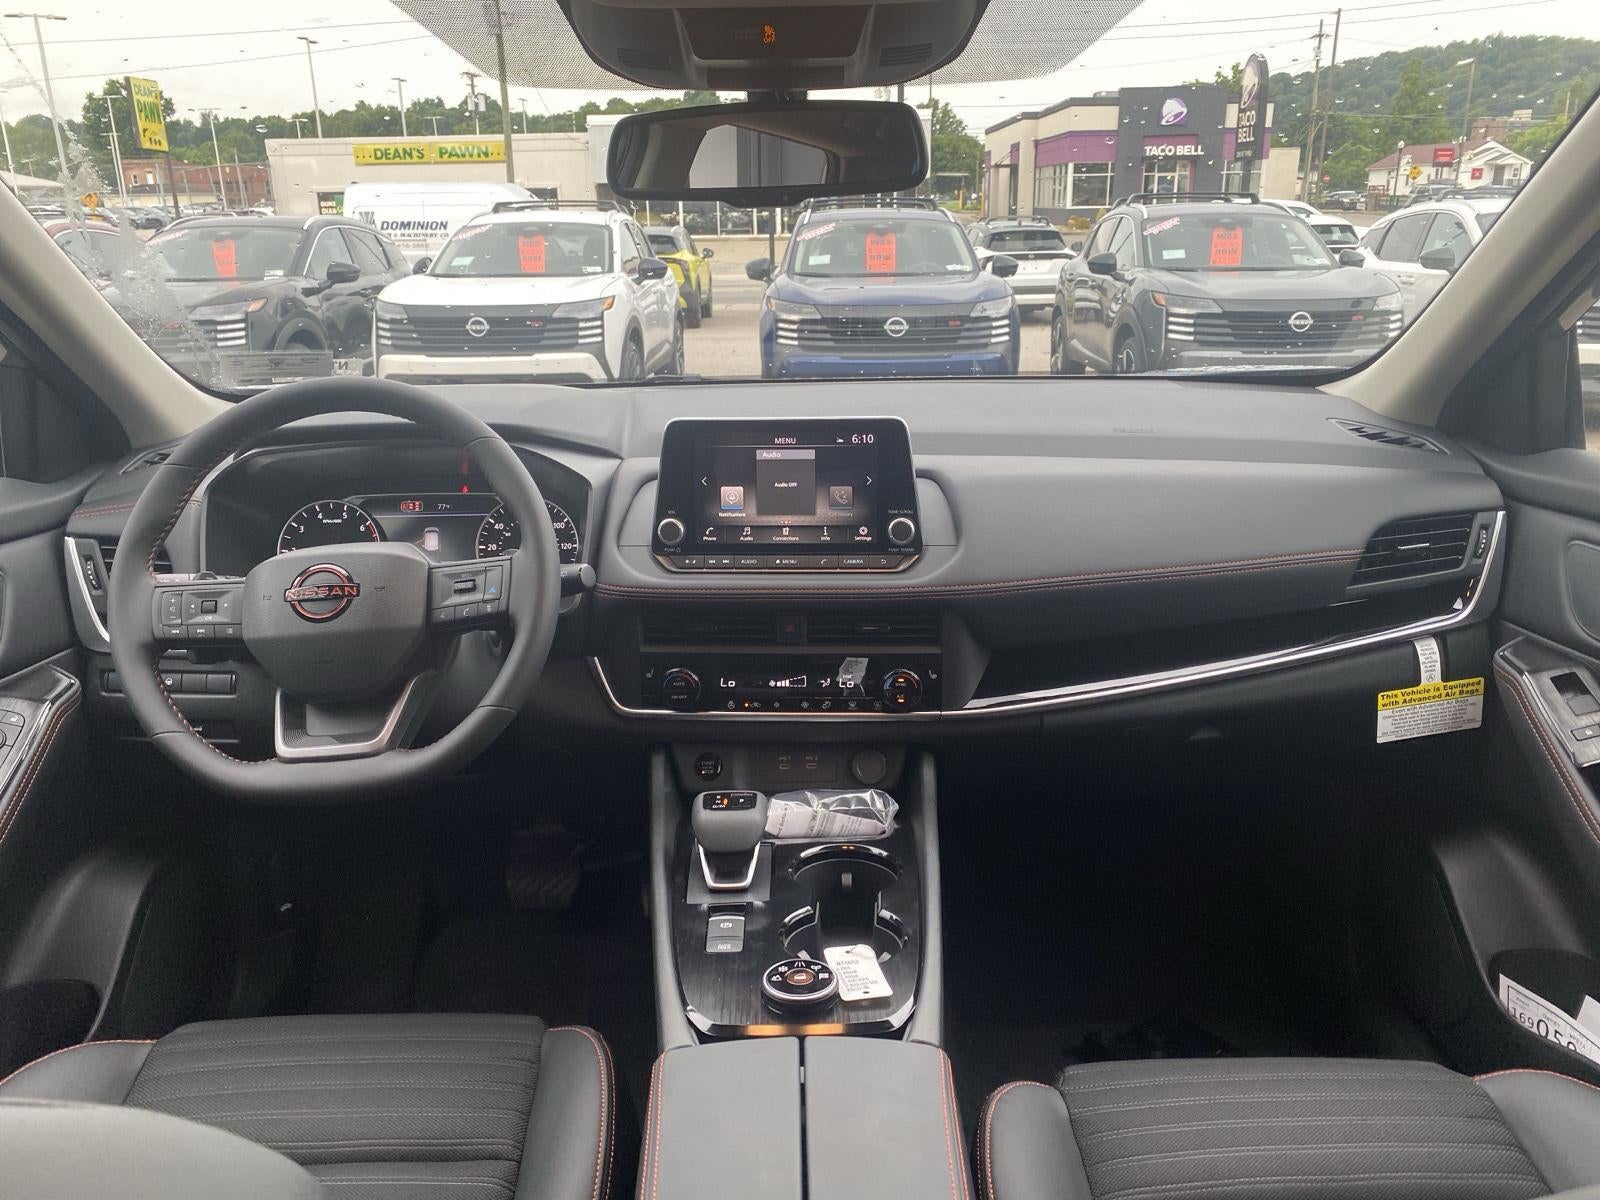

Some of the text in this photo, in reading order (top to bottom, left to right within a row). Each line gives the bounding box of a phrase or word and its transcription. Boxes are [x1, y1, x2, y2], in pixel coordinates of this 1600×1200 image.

[137, 99, 162, 124] PAWN
[1238, 110, 1256, 128] TACO
[1238, 126, 1254, 143] BELL
[374, 146, 490, 160] DEAN'S PAWN
[1144, 145, 1204, 156] TACO BELL
[380, 220, 448, 231] DOMINION
[852, 434, 874, 444] 6:10
[286, 586, 357, 599] NISSAN
[720, 677, 854, 688] Lo Lo
[1400, 688, 1431, 698] Vehicle
[1443, 680, 1481, 691] Equipped
[1381, 700, 1400, 708] with
[1402, 693, 1442, 705] Advanced
[1459, 688, 1480, 696] Bags
[1418, 702, 1446, 710] Advanced
[1511, 1007, 1534, 1029] 169
